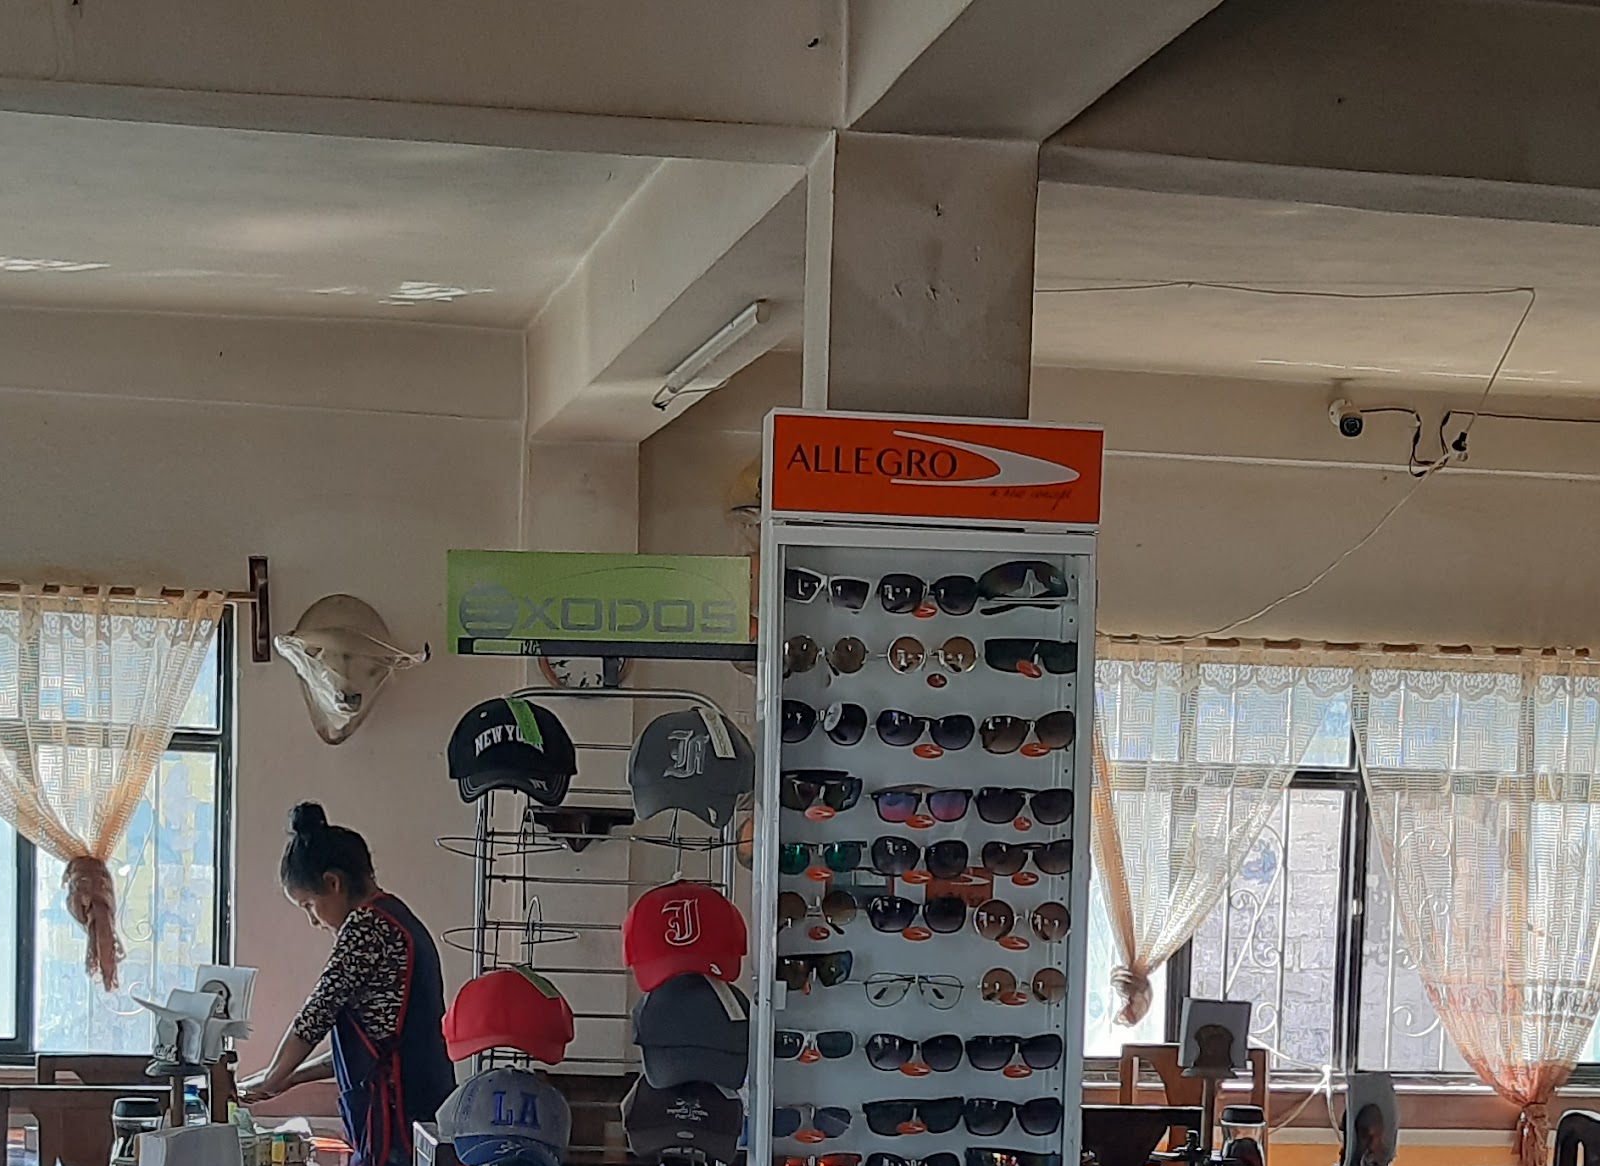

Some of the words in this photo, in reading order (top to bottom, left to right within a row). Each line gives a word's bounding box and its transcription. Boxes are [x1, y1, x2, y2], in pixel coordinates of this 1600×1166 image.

[786, 443, 958, 478] ALLEGRO
[459, 583, 738, 638] EXODOS
[475, 724, 503, 757] NEW
[504, 723, 545, 755] YO
[491, 1090, 541, 1130] LA
